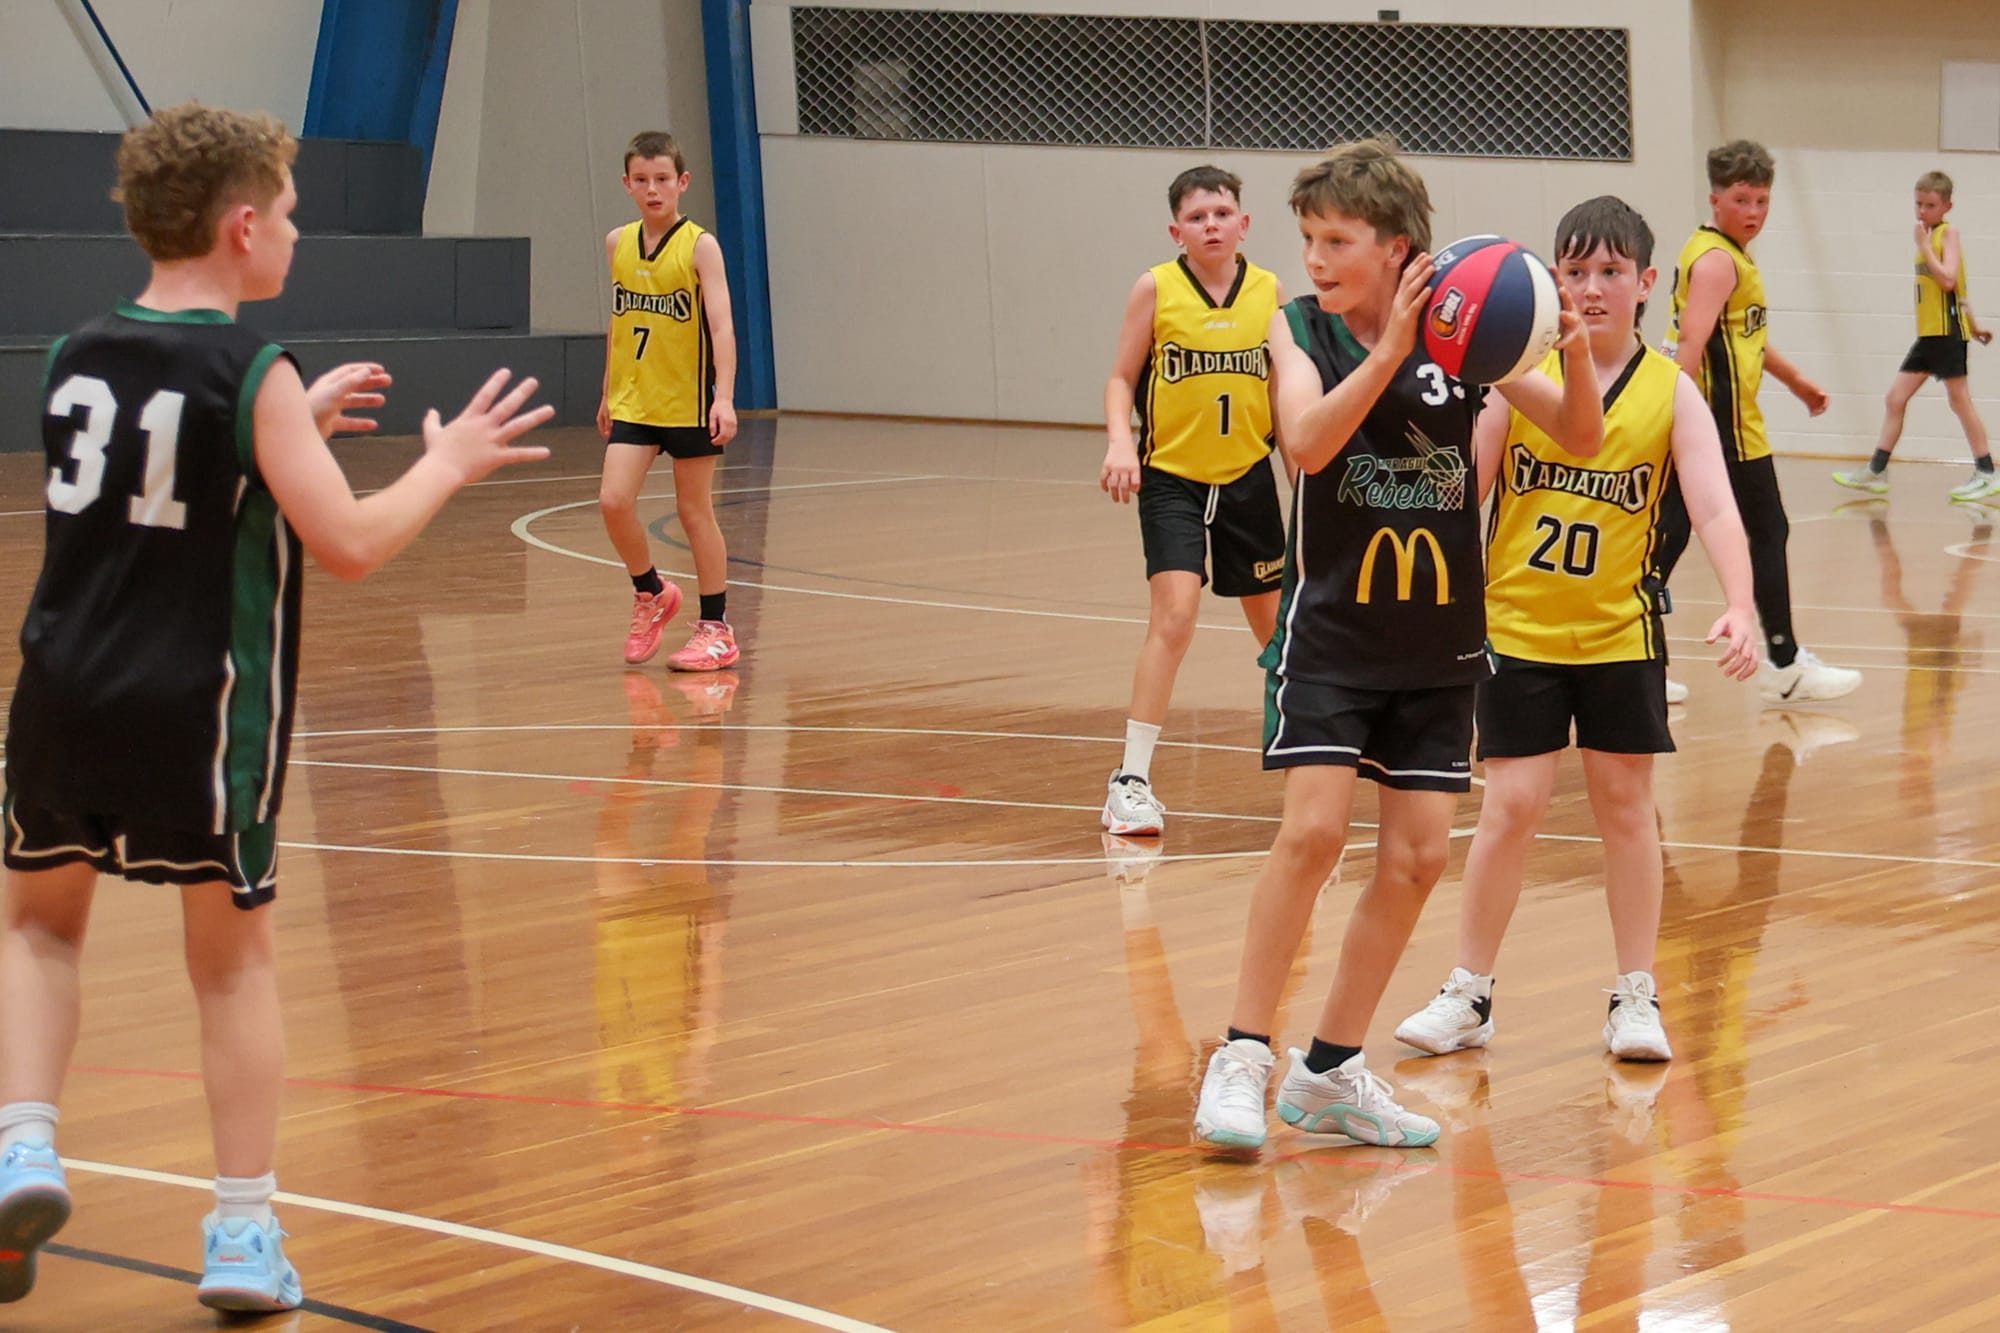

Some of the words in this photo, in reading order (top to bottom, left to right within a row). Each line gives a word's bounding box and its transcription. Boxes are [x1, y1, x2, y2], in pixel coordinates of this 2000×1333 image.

[612, 281, 691, 322] GADIATORS
[632, 326, 651, 361] 7
[1416, 363, 1466, 406] 3
[1215, 393, 1232, 436] 1
[45, 374, 188, 530] 31
[1337, 454, 1442, 510] Rebels
[1510, 443, 1654, 515] GLADIATORS
[1527, 514, 1600, 578] 20
